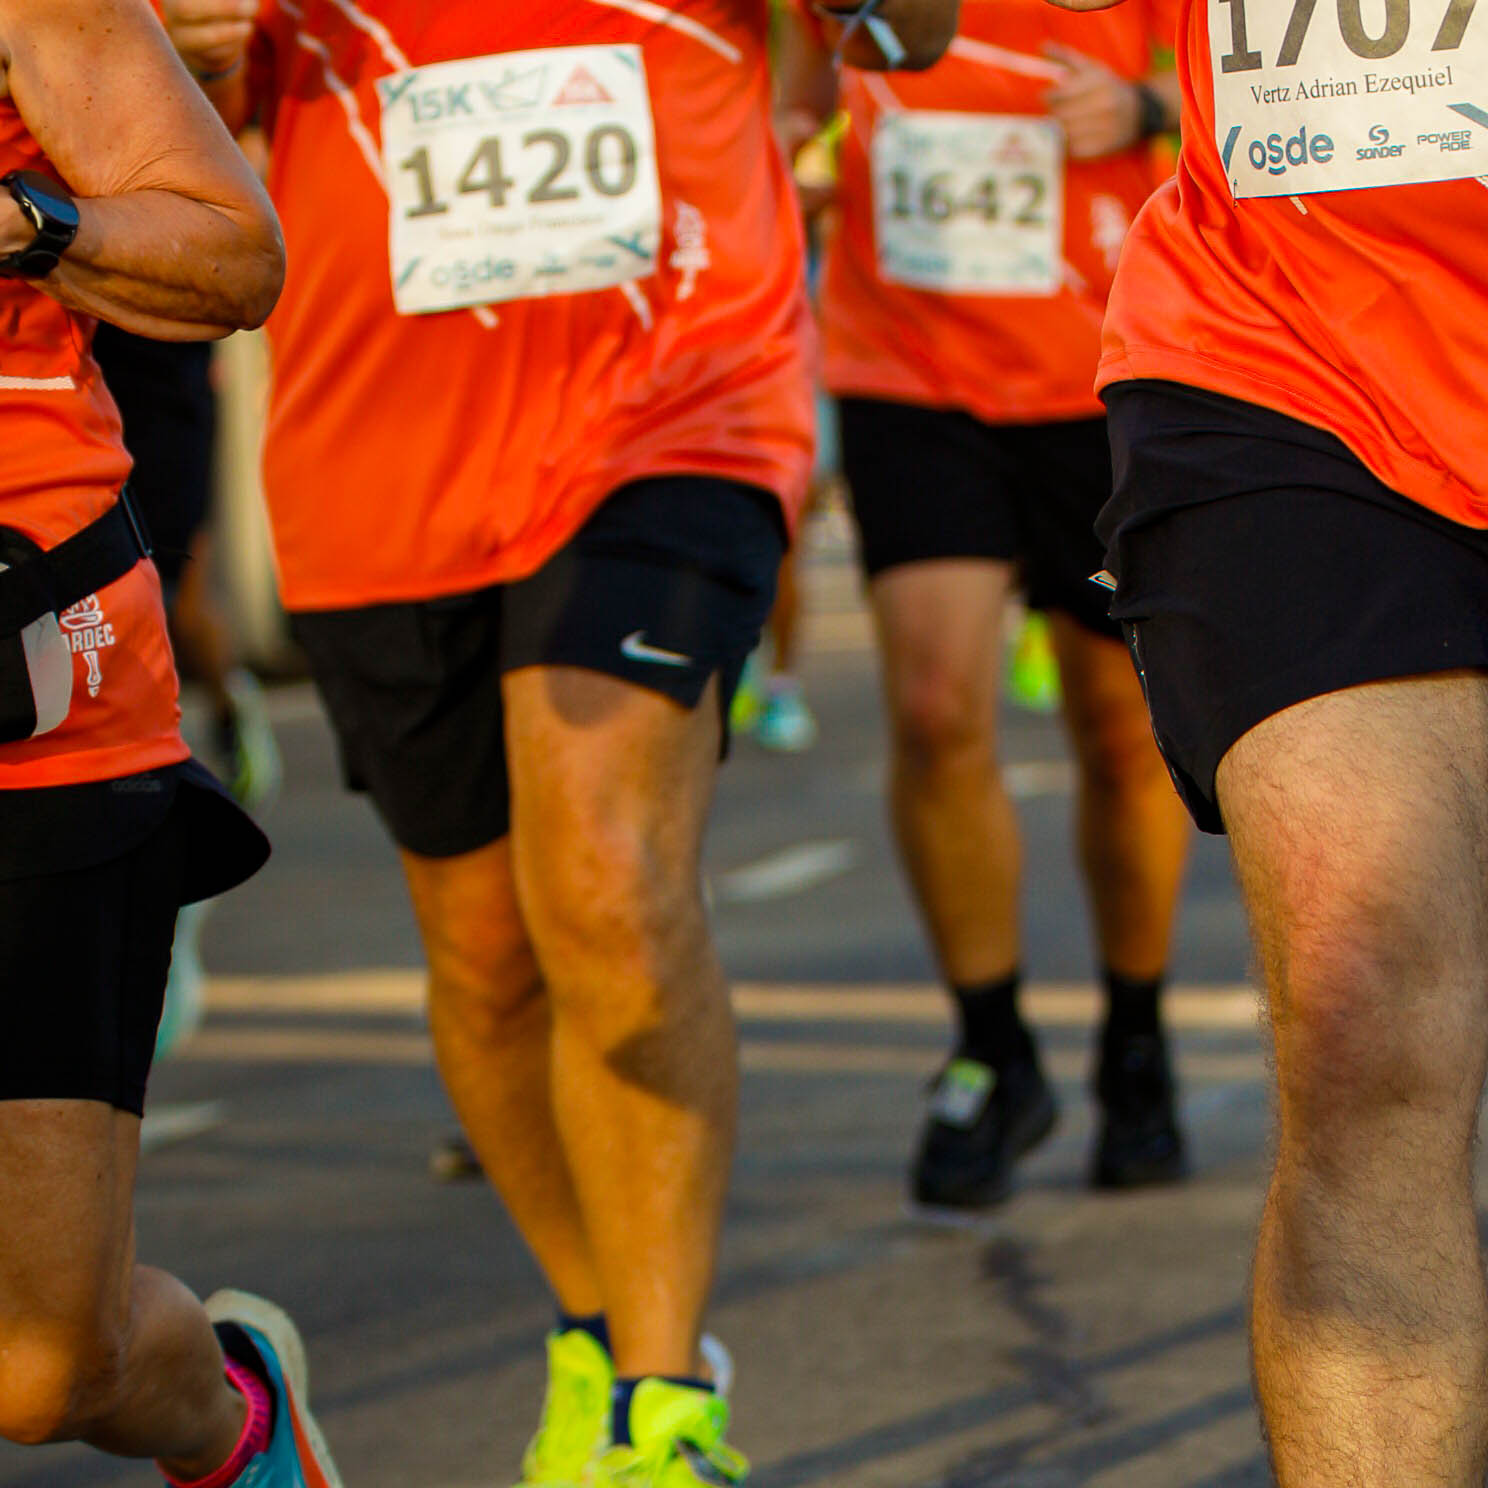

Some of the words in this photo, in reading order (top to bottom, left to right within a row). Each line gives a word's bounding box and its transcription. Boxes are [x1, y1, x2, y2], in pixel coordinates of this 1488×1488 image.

[1250, 85, 1291, 104] Vertz
[1295, 78, 1358, 101] Adrian
[1364, 65, 1454, 95] Ezequiel
[1248, 125, 1335, 171] osde
[1416, 130, 1472, 145] POWER
[400, 122, 638, 221] 1420
[889, 168, 1046, 229] 1642
